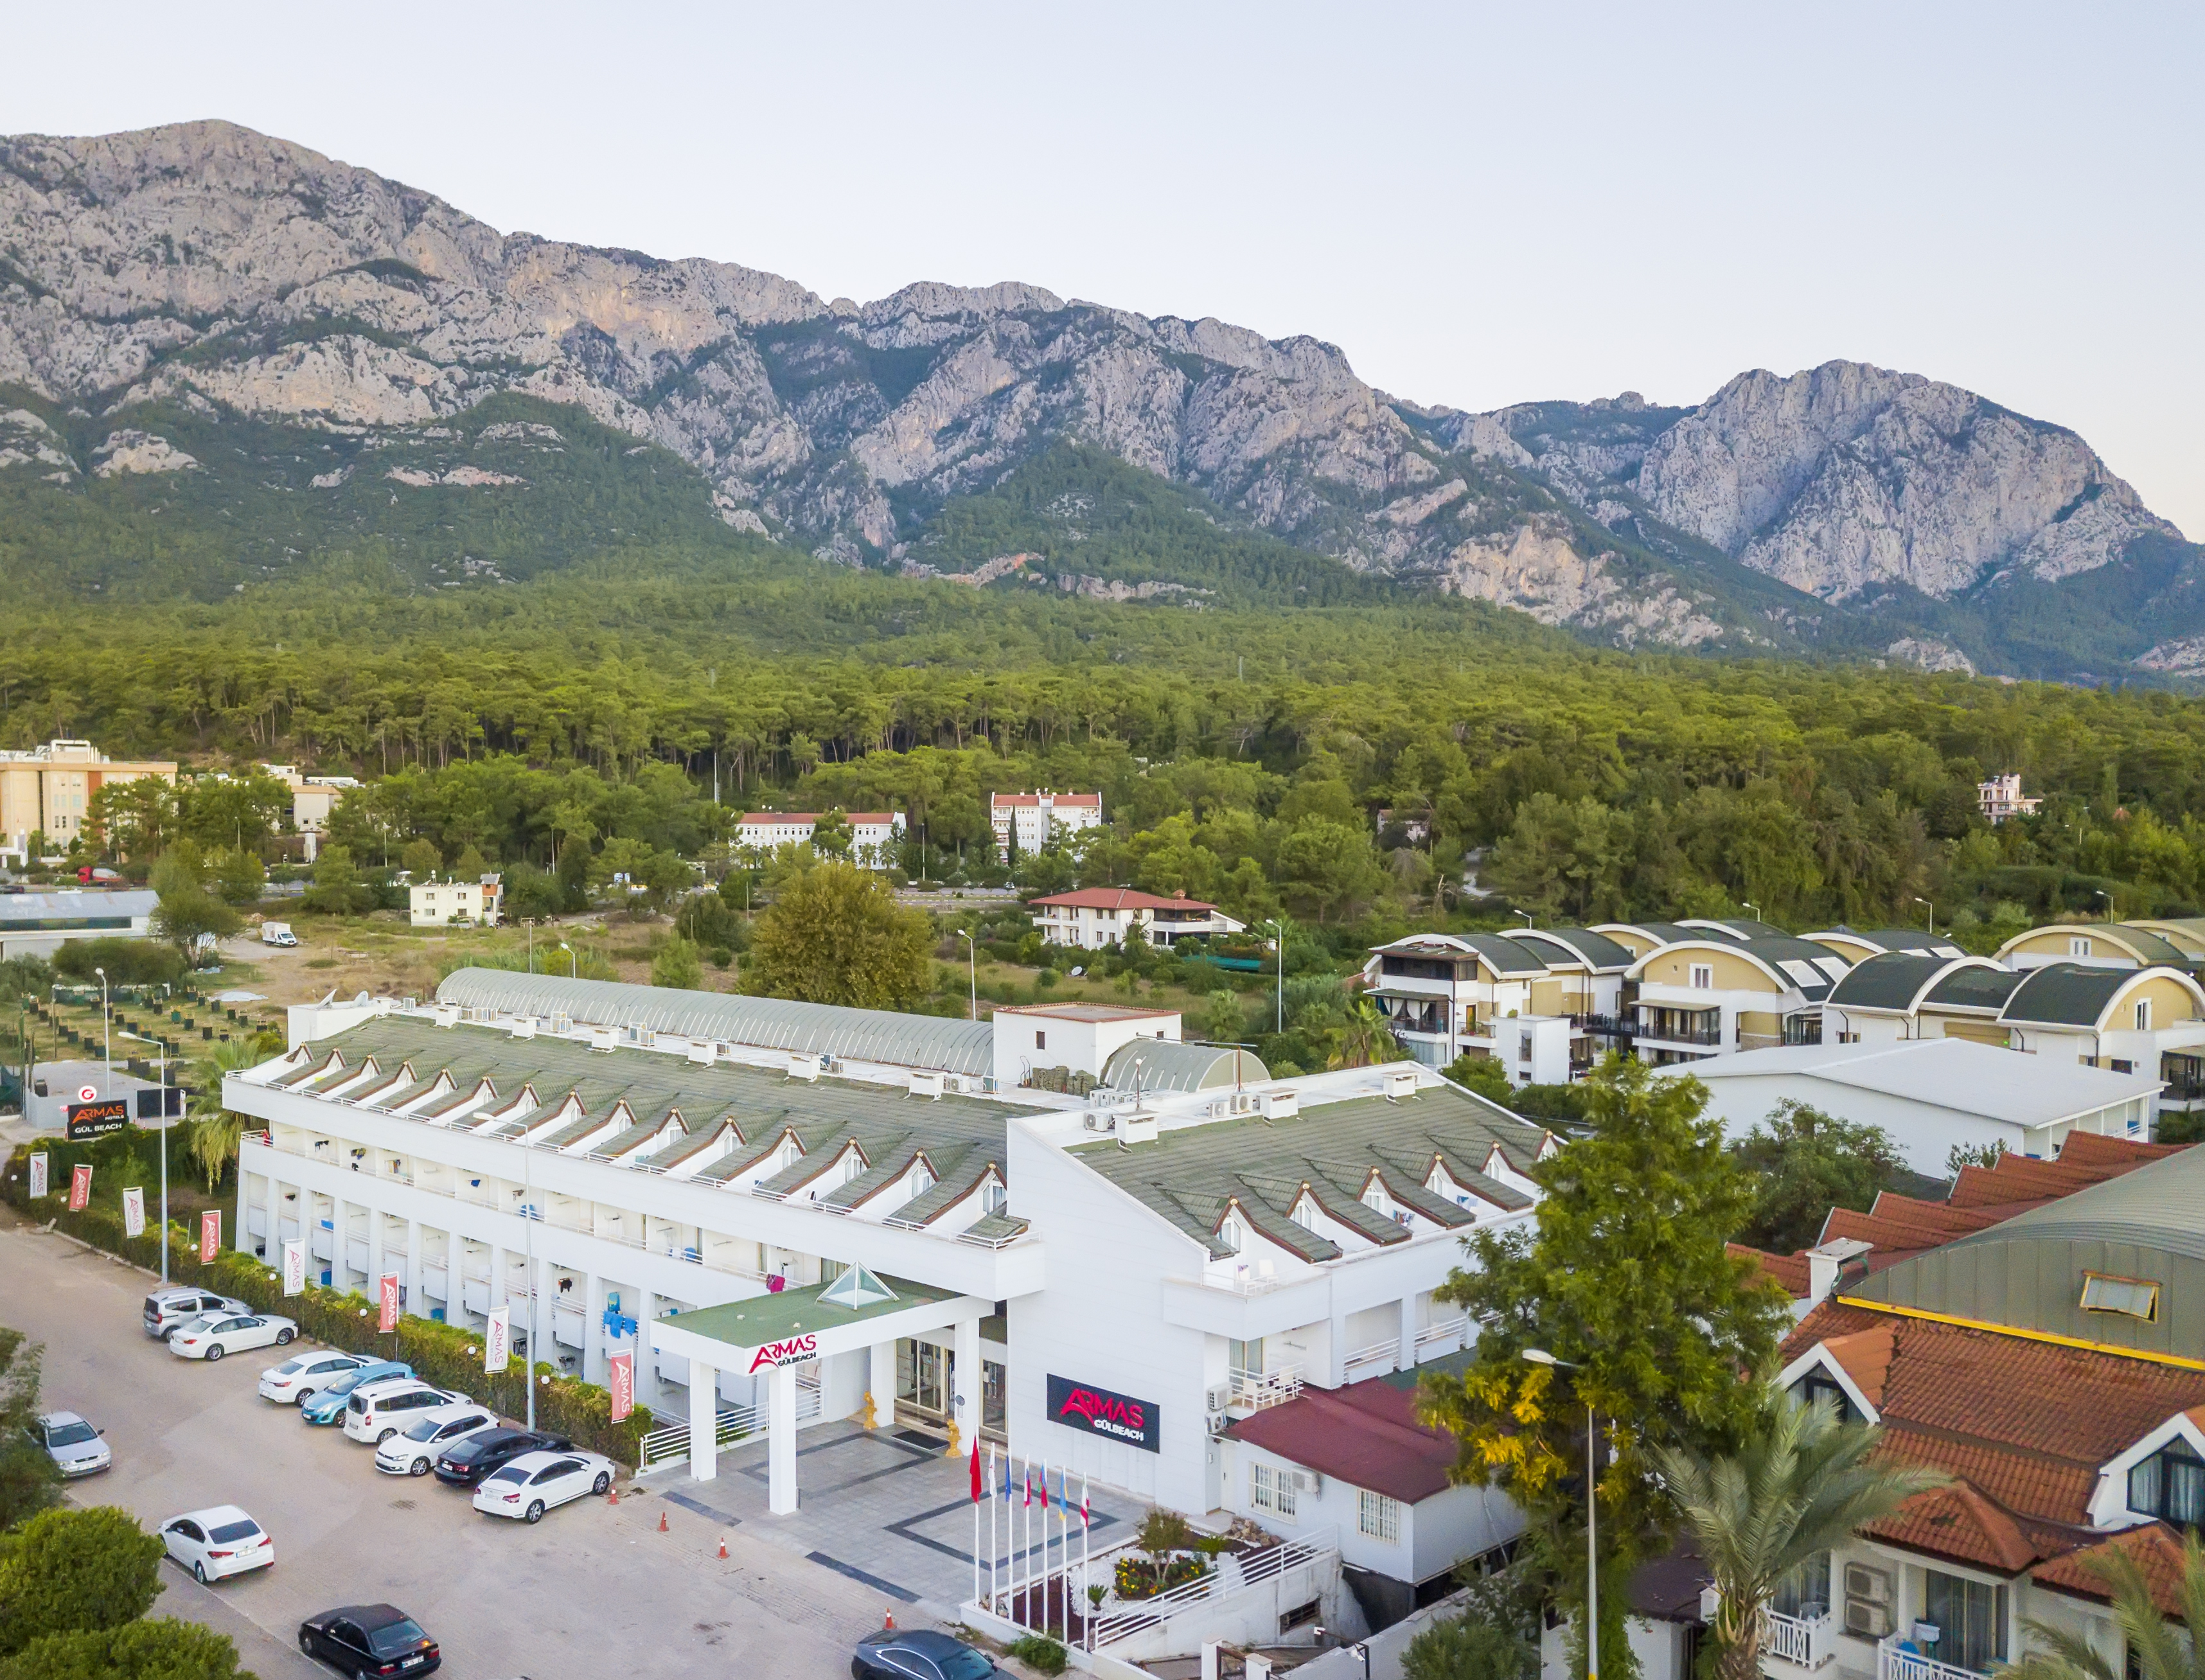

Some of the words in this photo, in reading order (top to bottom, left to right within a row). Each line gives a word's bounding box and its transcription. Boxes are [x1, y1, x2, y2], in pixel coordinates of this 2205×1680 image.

[71, 1105, 124, 1124] ARMAS
[94, 1123, 122, 1132] BEACH
[34, 1160, 44, 1192] ARMAS
[76, 1171, 87, 1205] ARMAS
[128, 1197, 141, 1230] ARMAS
[206, 1219, 216, 1257] ARMAS
[289, 1249, 300, 1287] ARMAS
[384, 1282, 396, 1325] ARMAS
[492, 1320, 504, 1363] ARMAS
[748, 1334, 817, 1374] ARMAS
[777, 1352, 817, 1366] GÜLBEACH
[615, 1361, 630, 1413] ARMAS
[1060, 1388, 1144, 1428] ARMAS
[1094, 1419, 1144, 1441] GÜLBEACH
